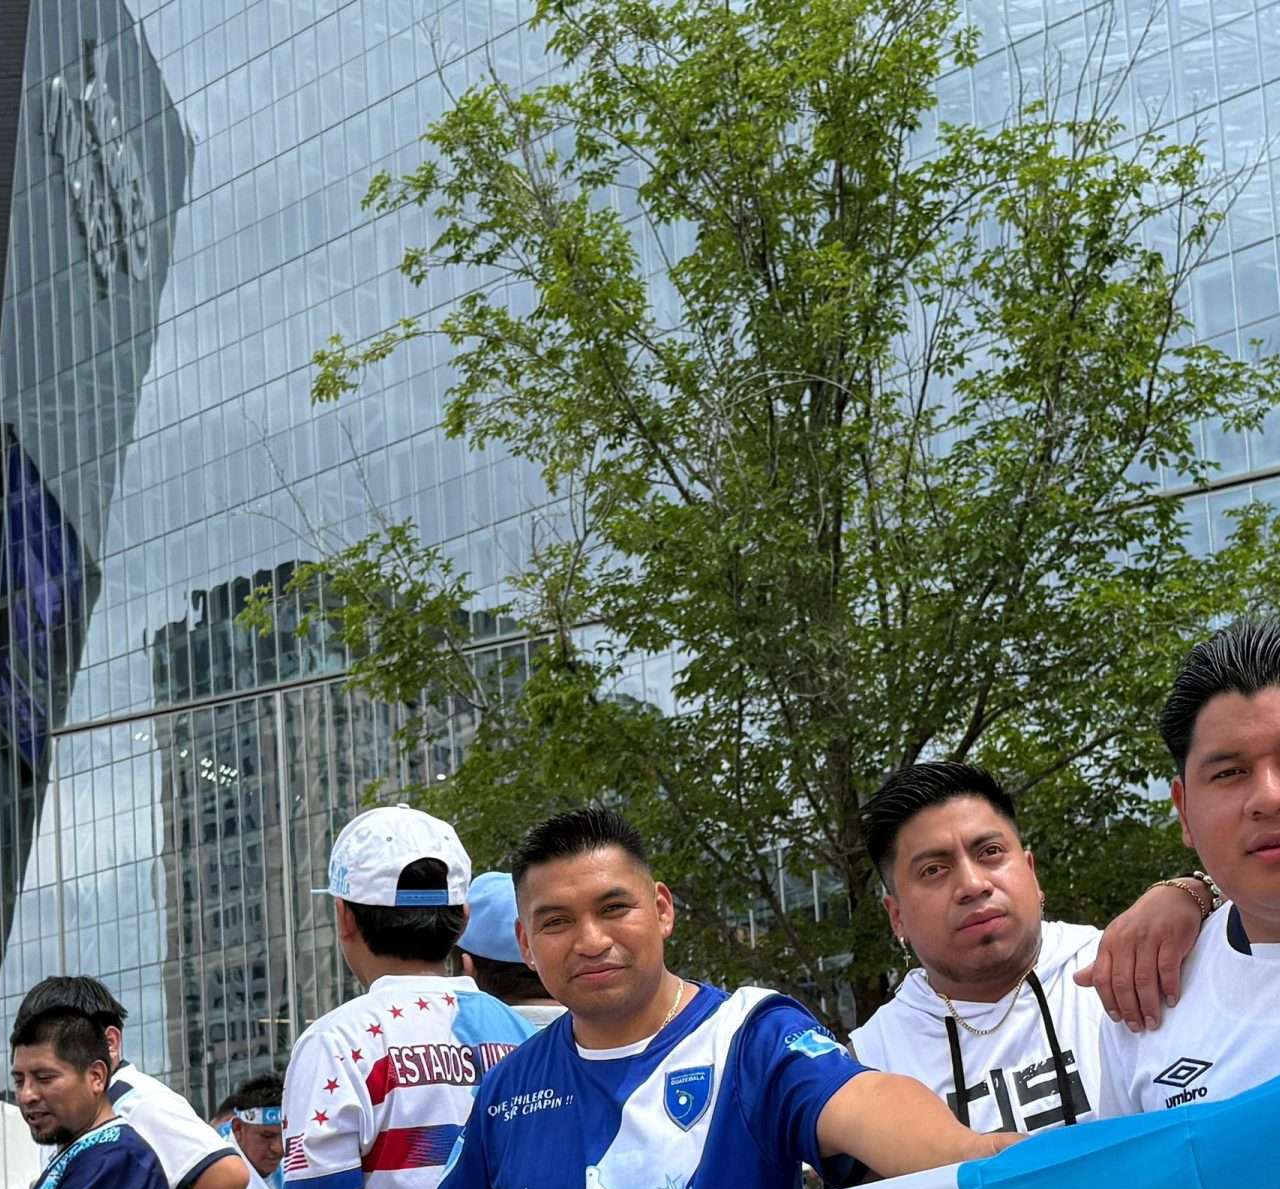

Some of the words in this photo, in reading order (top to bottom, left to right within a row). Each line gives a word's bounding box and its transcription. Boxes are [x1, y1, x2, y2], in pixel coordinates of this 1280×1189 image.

[389, 1044, 476, 1084] ESTADOS
[522, 1097, 563, 1115] CHAPIN
[1165, 1087, 1208, 1109] umbro
